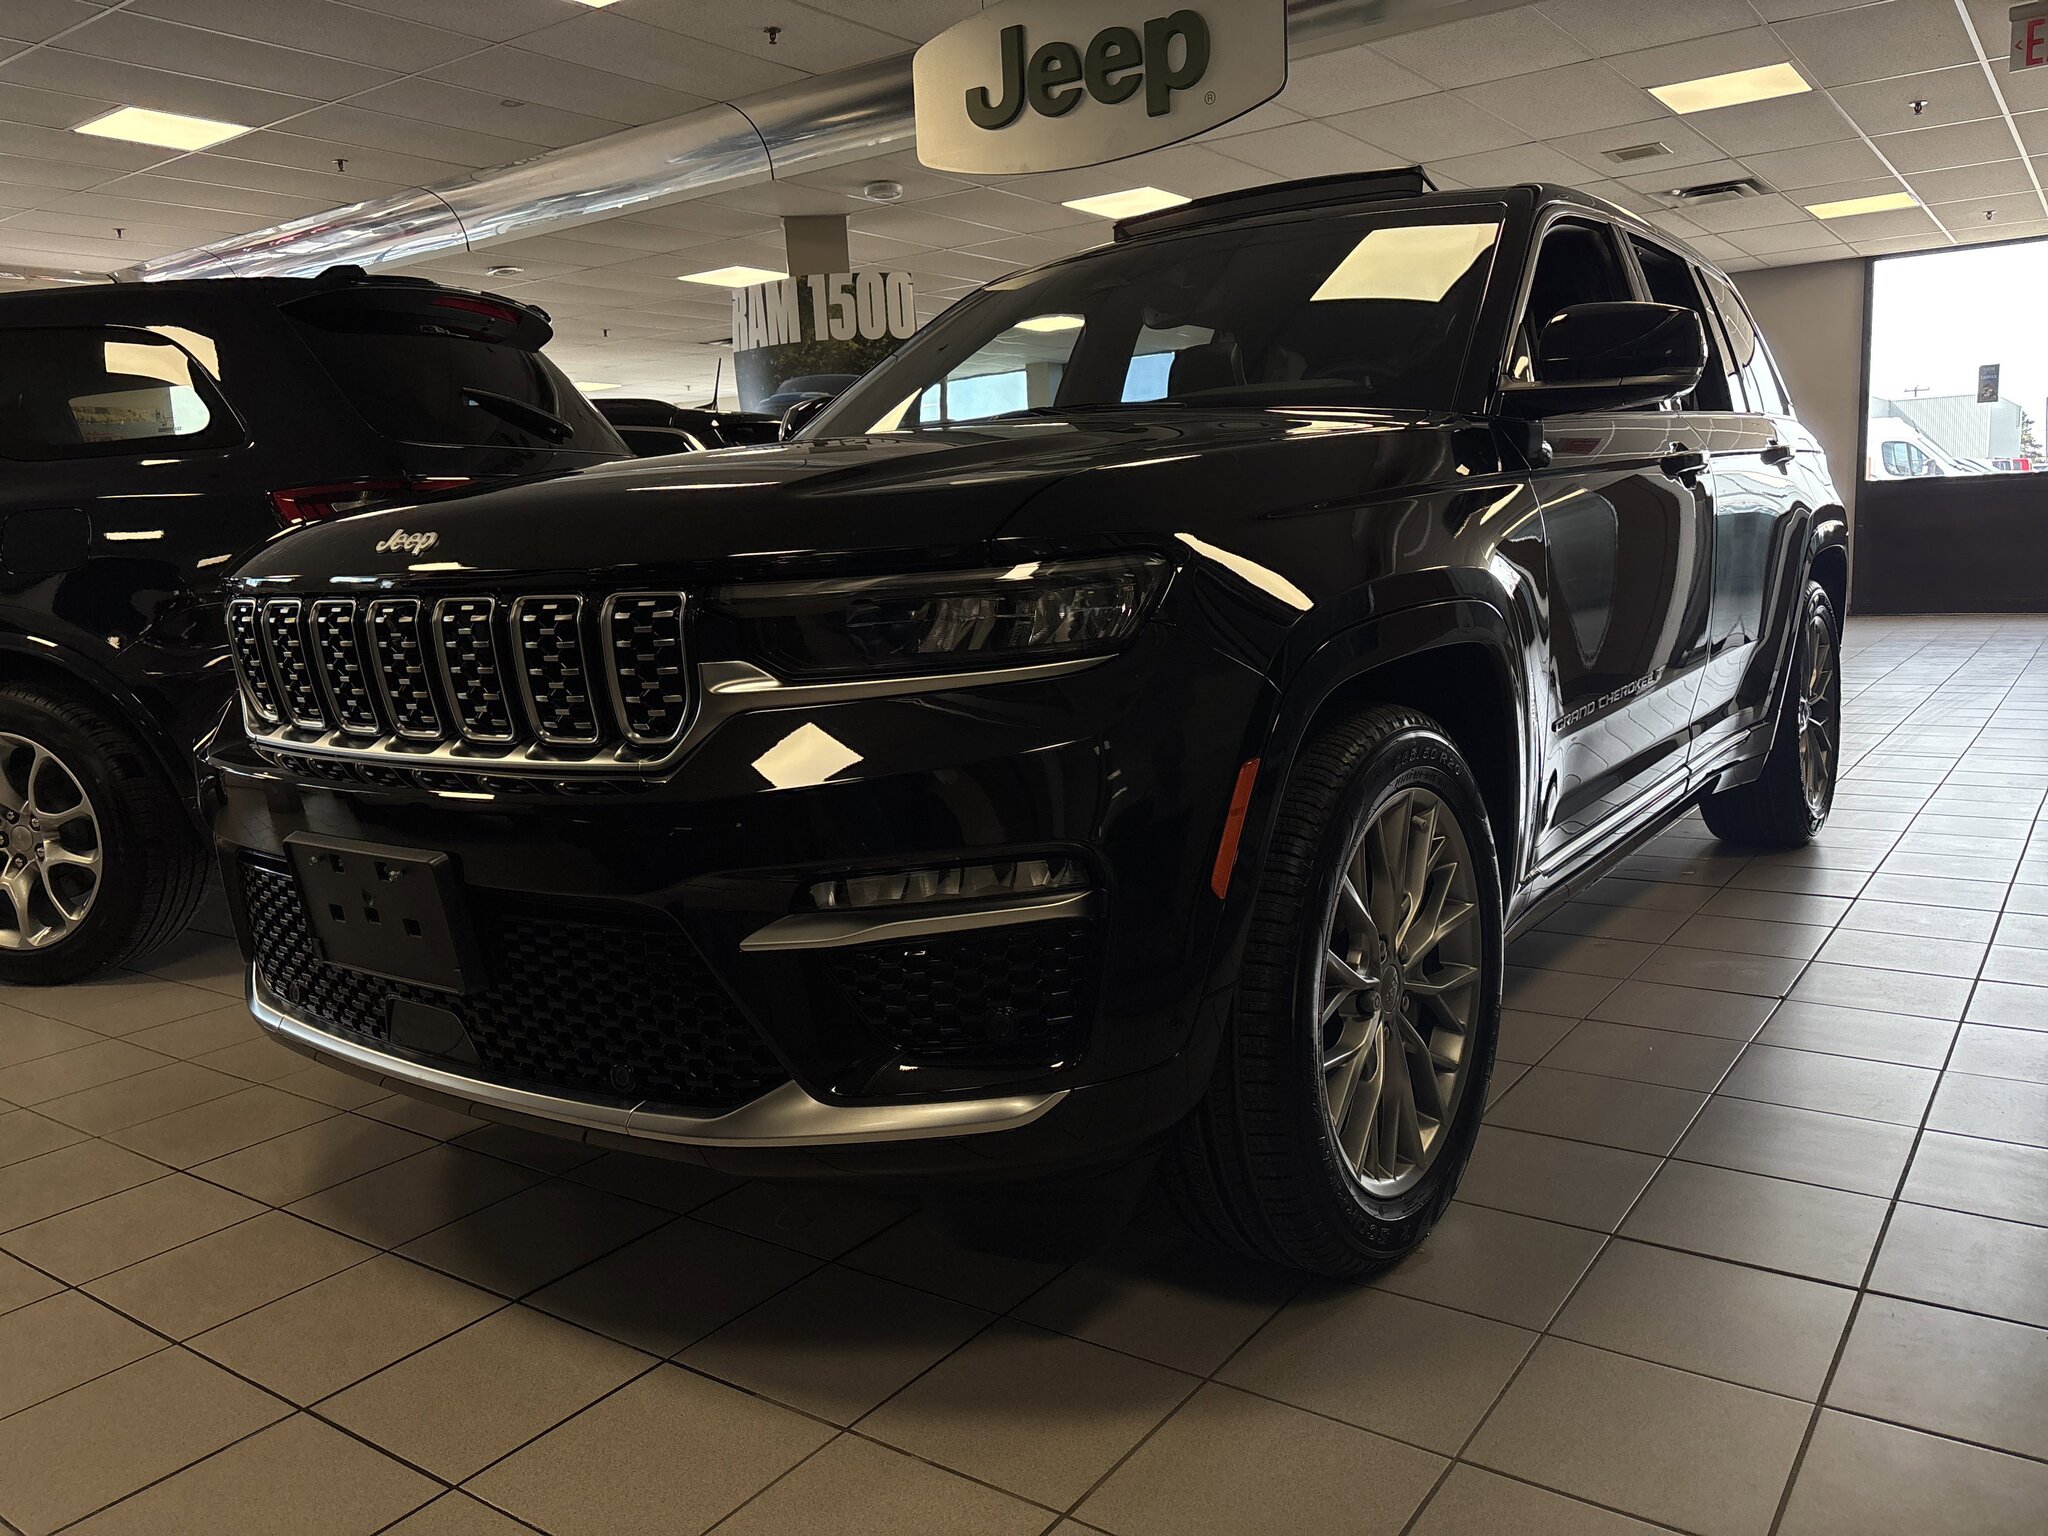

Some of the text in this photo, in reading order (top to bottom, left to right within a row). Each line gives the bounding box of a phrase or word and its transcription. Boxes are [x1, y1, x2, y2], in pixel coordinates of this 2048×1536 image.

[965, 9, 1211, 131] Jeep
[2026, 18, 2048, 66] E
[732, 271, 915, 353] RAM 1500
[375, 528, 439, 557] Jeep
[1554, 670, 1656, 732] GRAND CHEROKEE
